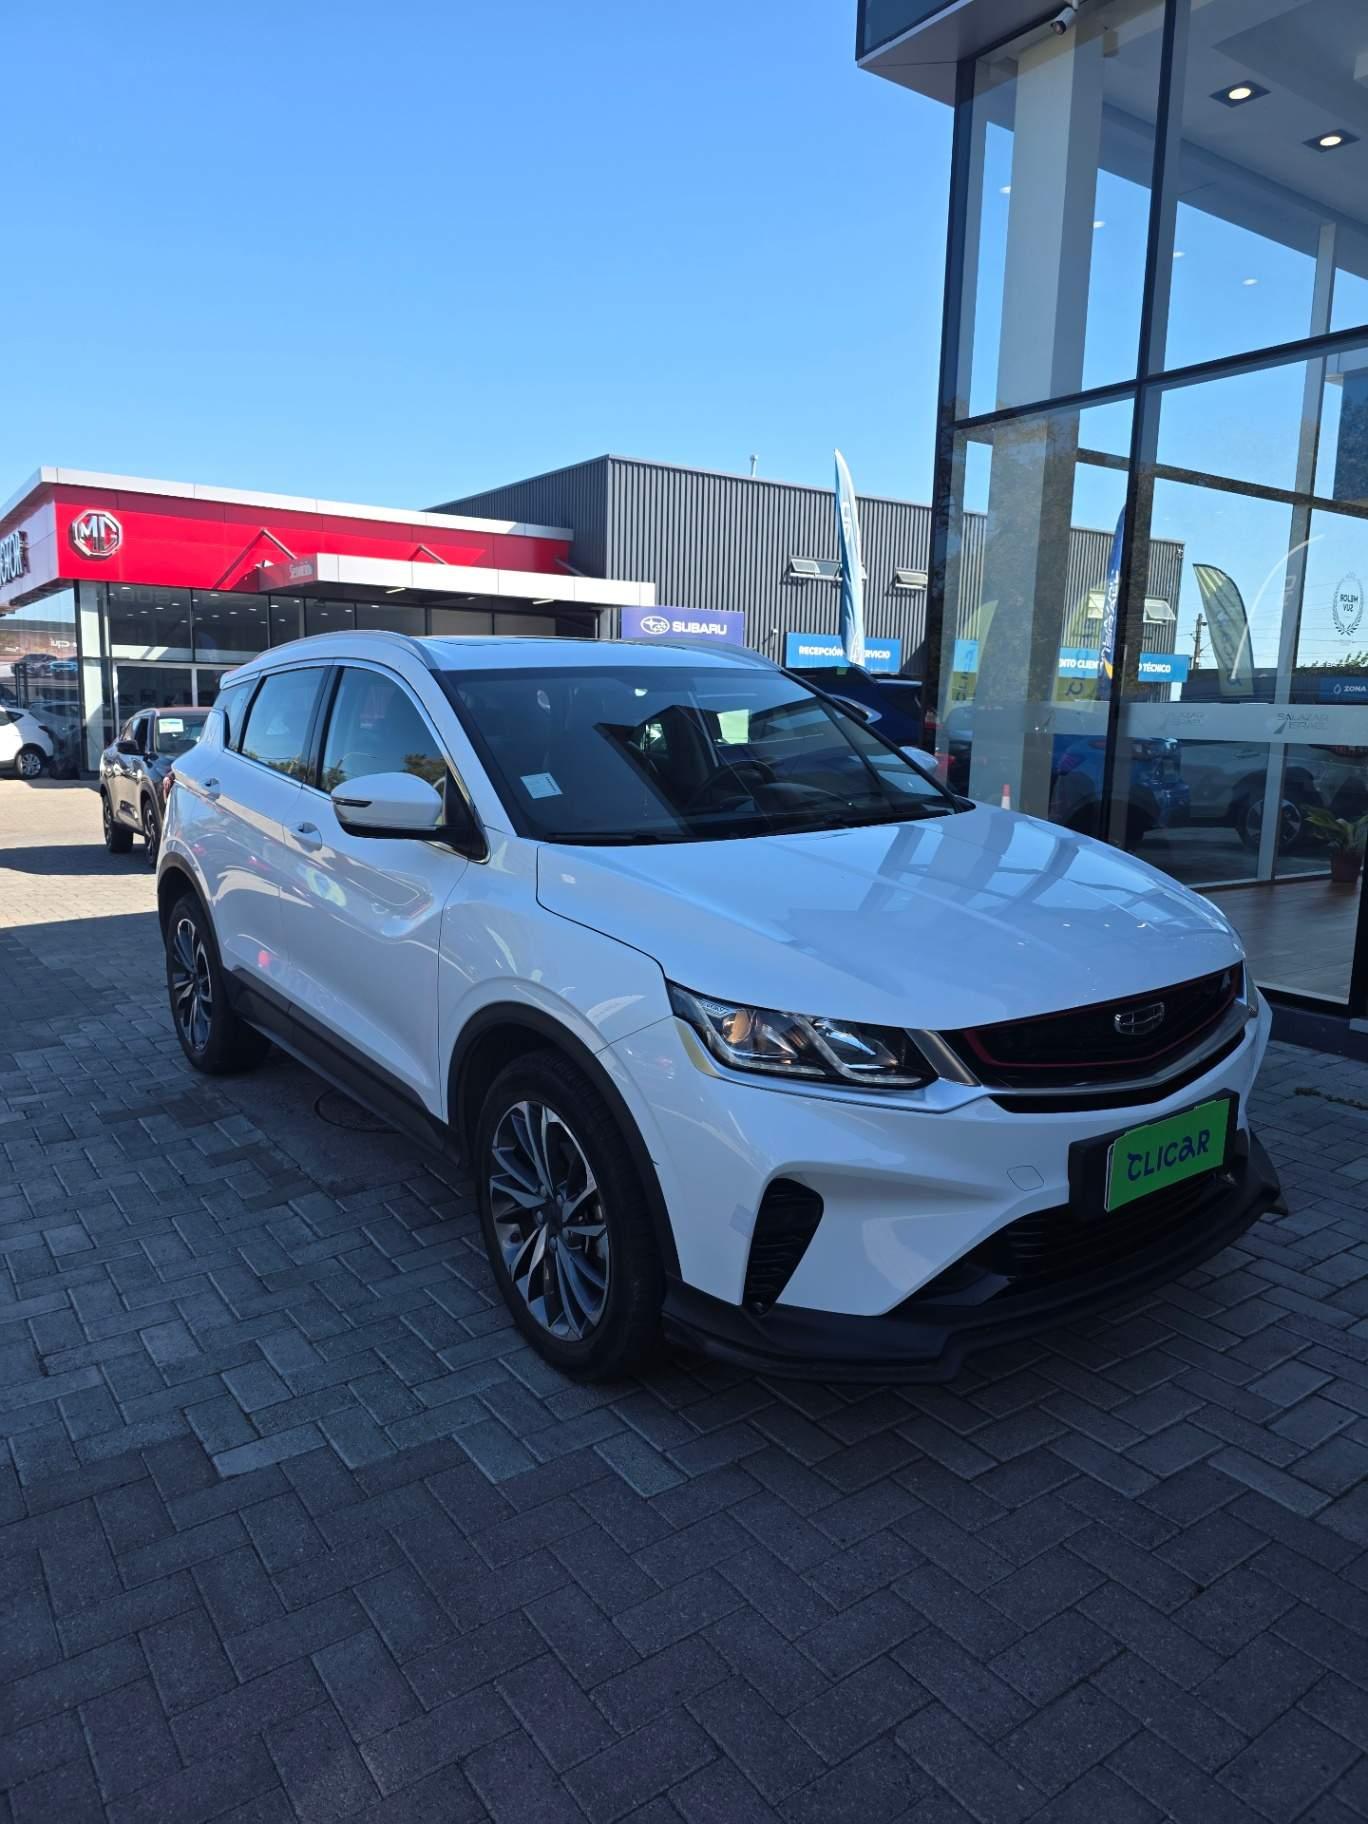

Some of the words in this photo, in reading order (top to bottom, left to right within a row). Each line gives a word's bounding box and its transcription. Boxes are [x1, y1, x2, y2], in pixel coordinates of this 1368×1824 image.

[77, 513, 120, 554] MG
[0, 531, 23, 584] OTOR
[672, 621, 728, 635] SUBARU
[798, 645, 844, 657] RECEPCIÓN
[1143, 661, 1172, 673] TÉCNICO
